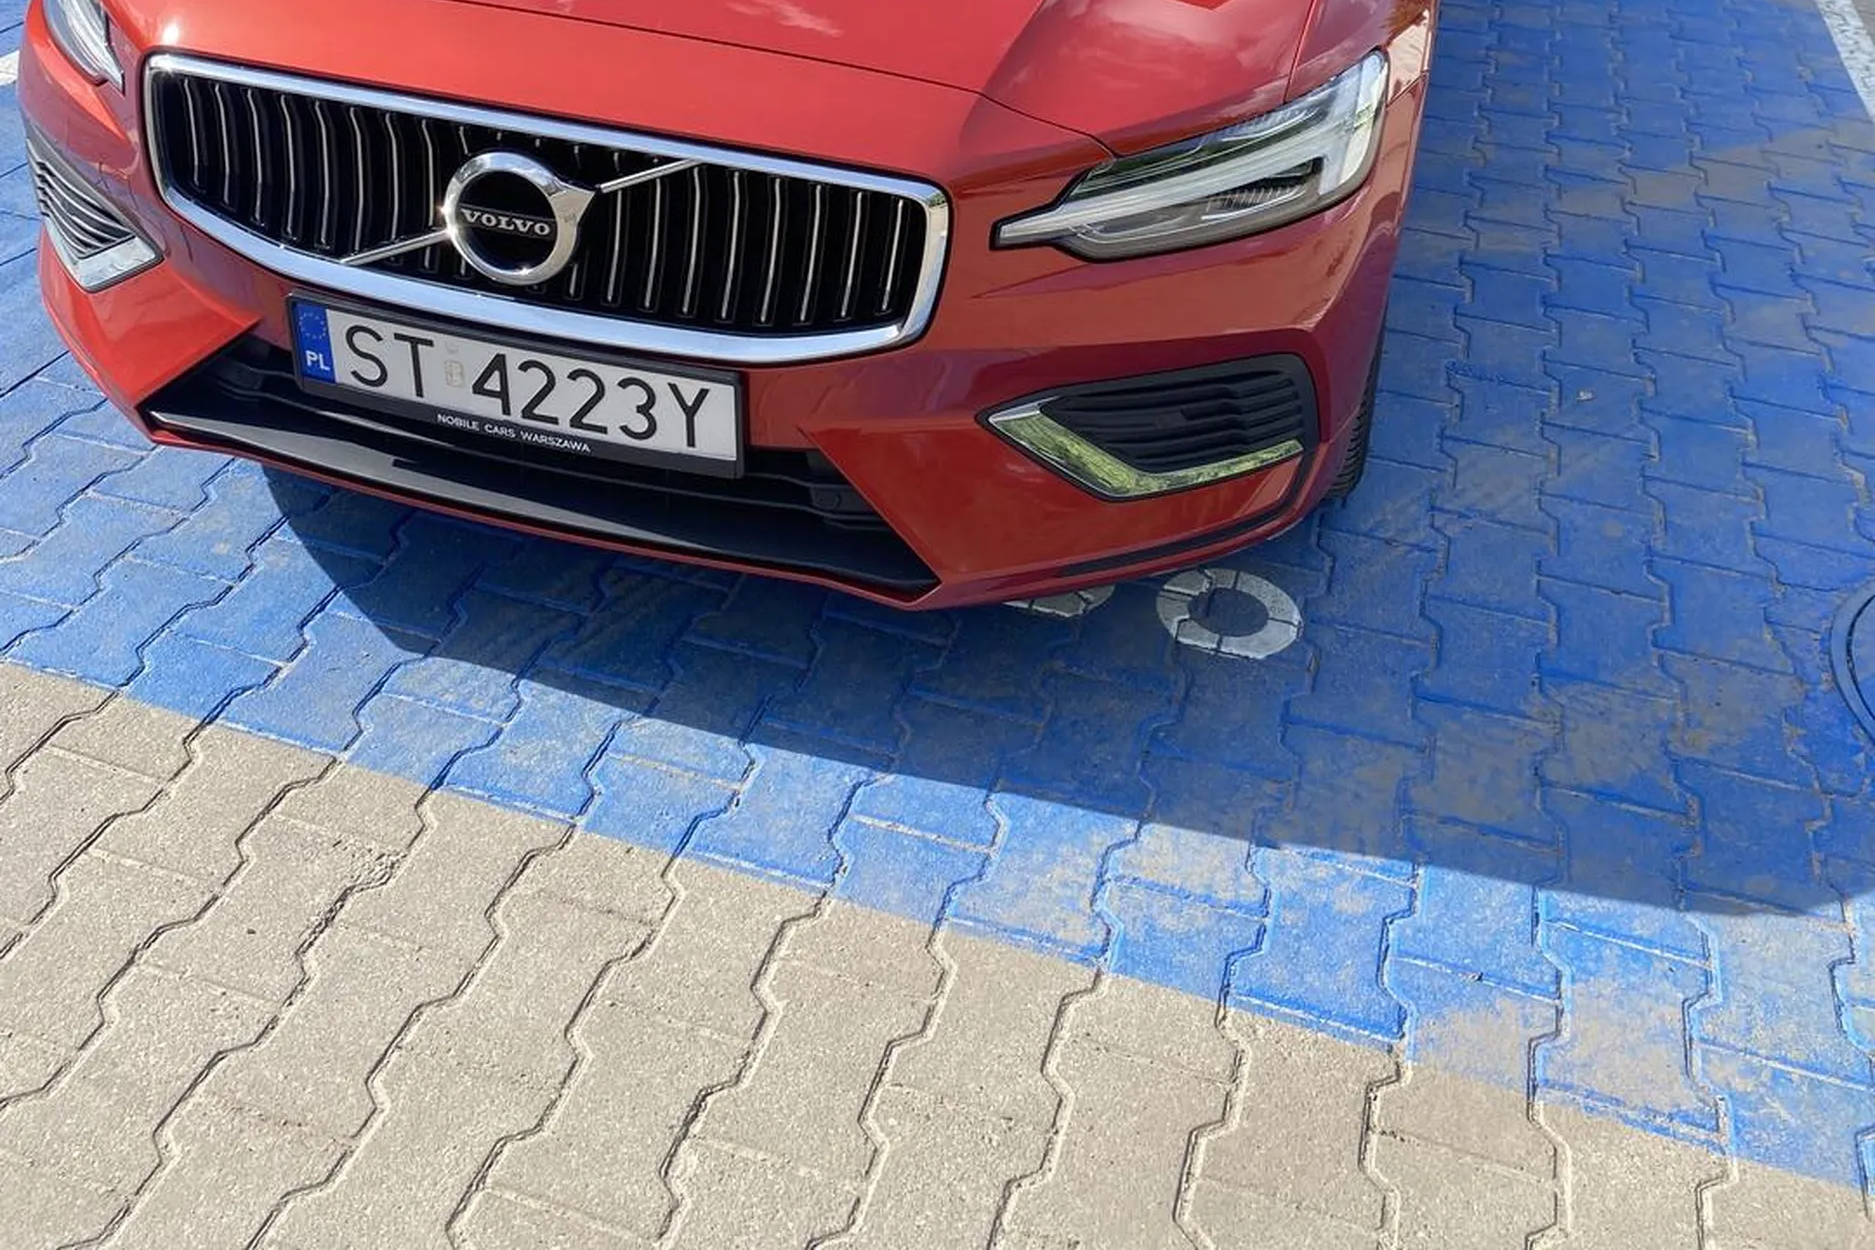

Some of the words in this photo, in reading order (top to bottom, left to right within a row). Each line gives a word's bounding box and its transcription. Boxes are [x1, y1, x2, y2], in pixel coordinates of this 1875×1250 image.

[460, 208, 550, 236] VOLVO
[305, 350, 331, 371] PL
[345, 324, 434, 399] ST
[472, 352, 711, 449] 4223Y
[437, 413, 480, 432] NOBILE
[484, 424, 516, 439] CARS
[520, 430, 591, 453] WARSZAWA
